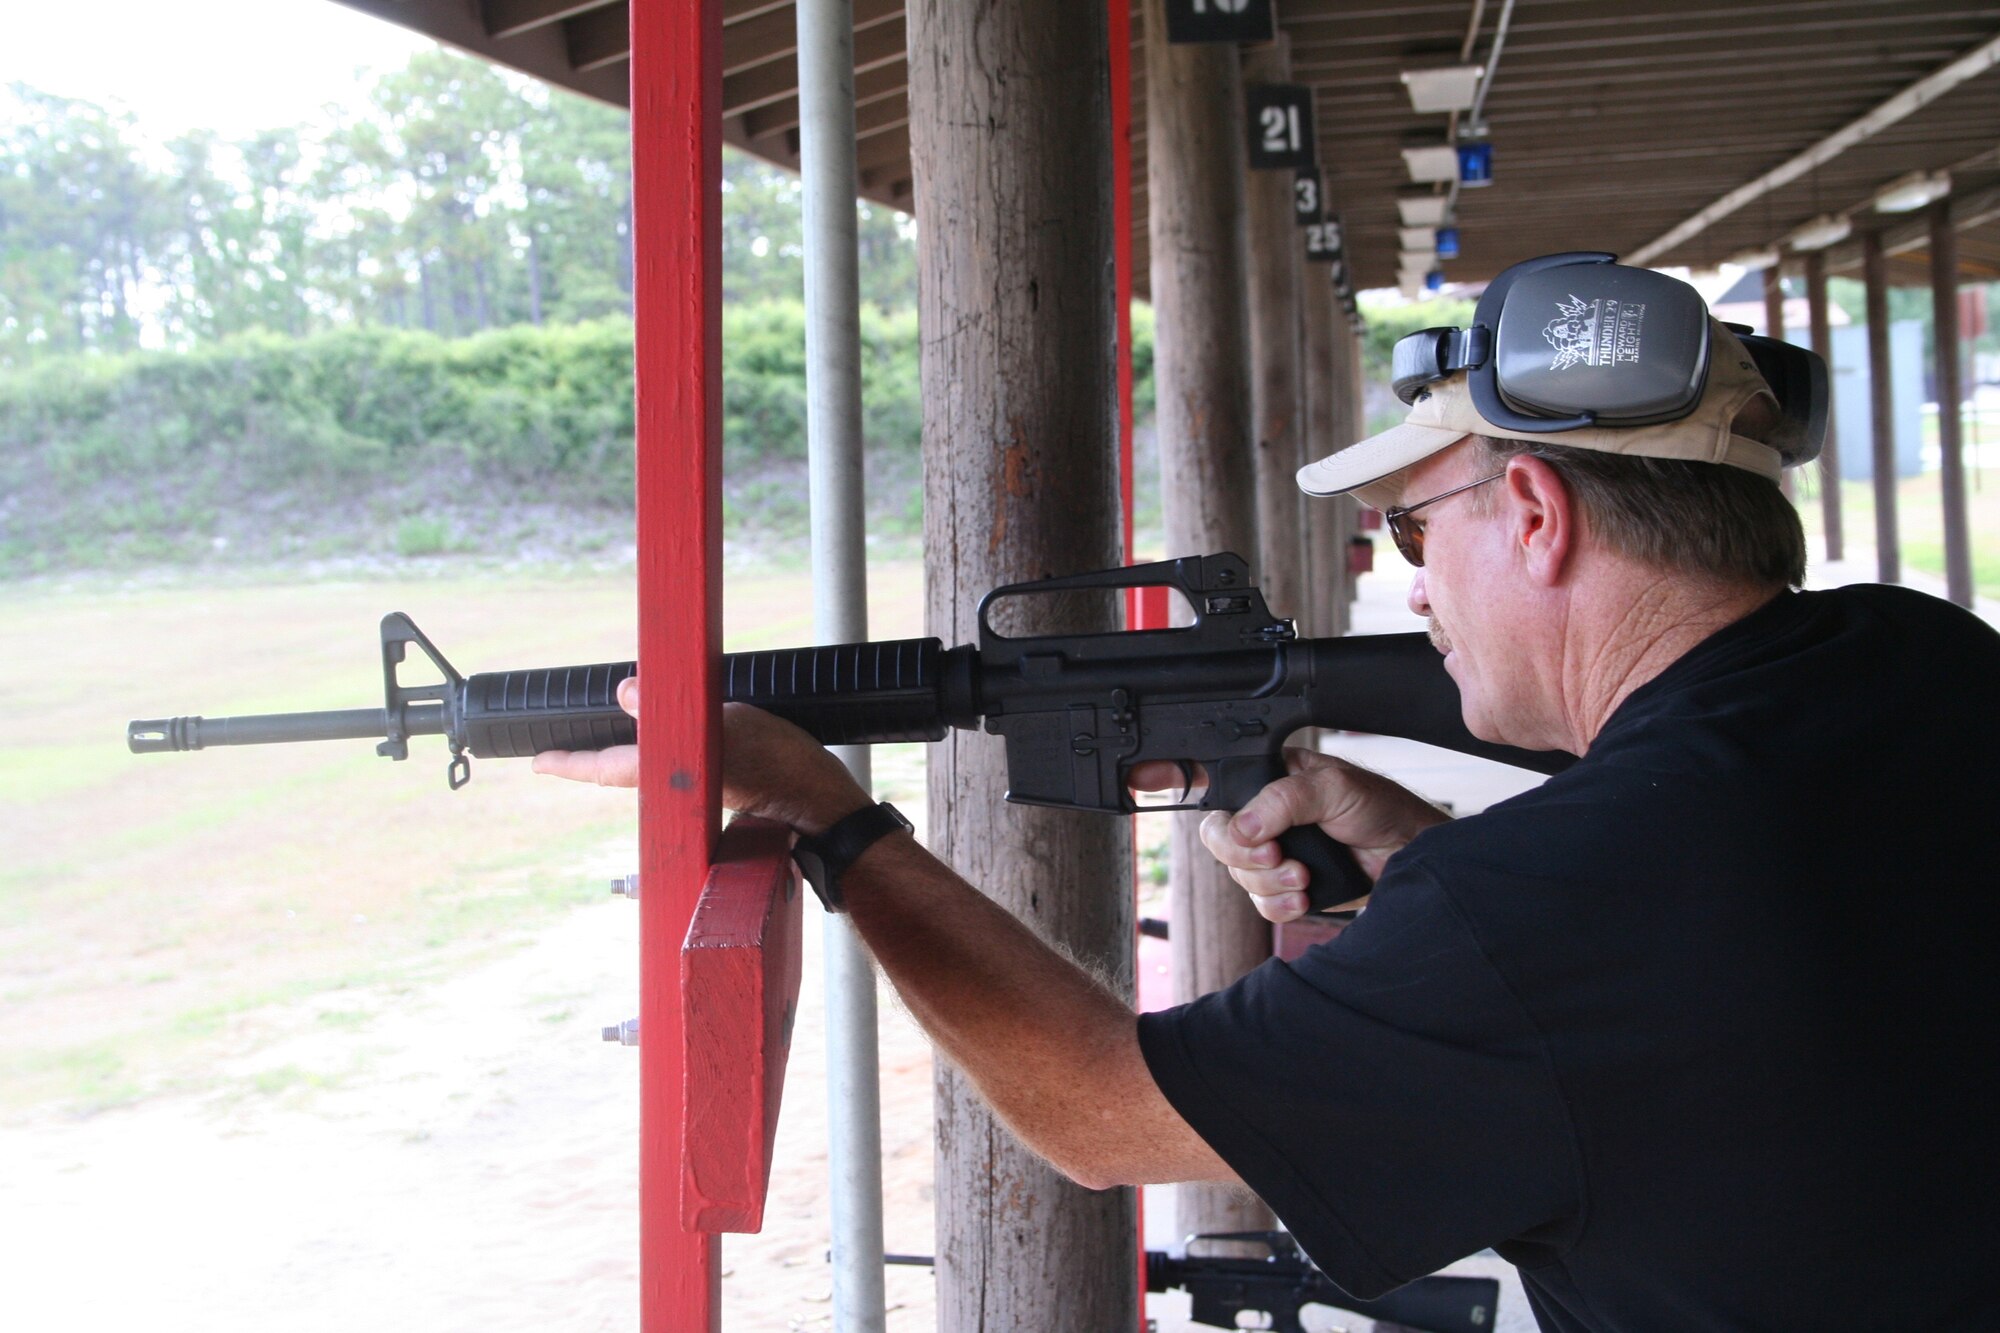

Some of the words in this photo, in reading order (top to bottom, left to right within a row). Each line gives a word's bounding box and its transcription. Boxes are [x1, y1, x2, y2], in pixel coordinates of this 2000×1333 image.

[1260, 104, 1300, 151] 21
[1306, 221, 1341, 252] 25
[1599, 315, 1616, 366] THUNDER
[1616, 320, 1627, 362] HOWARD
[1624, 321, 1637, 362] LEIGHT
